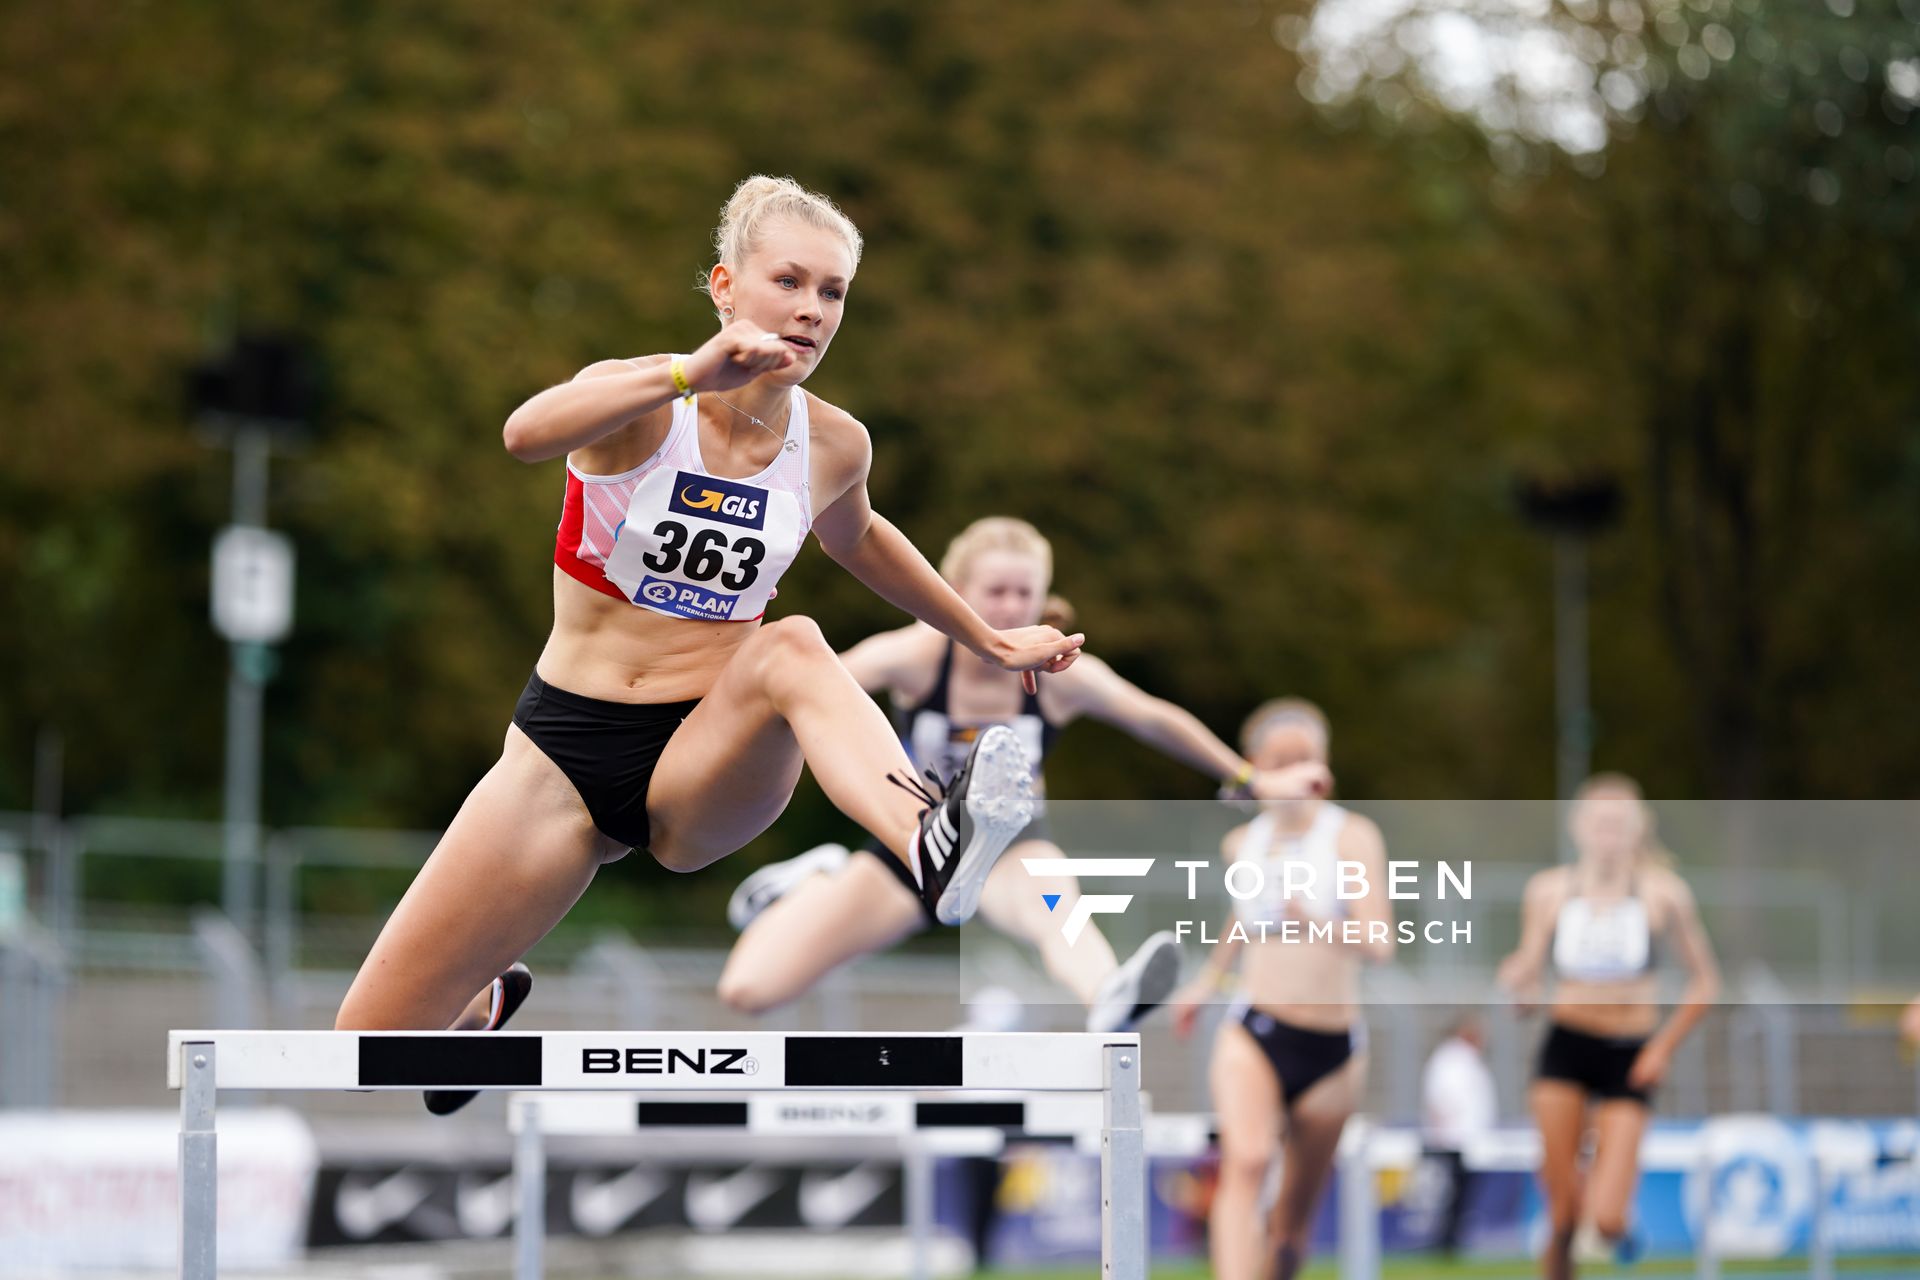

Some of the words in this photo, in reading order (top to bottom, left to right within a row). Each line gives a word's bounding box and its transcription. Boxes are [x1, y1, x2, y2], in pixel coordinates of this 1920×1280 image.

[721, 495, 760, 520] GLS
[642, 520, 766, 591] 363
[675, 603, 726, 620] INTERNATIONAL
[678, 589, 733, 614] PLAN
[582, 1048, 748, 1074] BENZ
